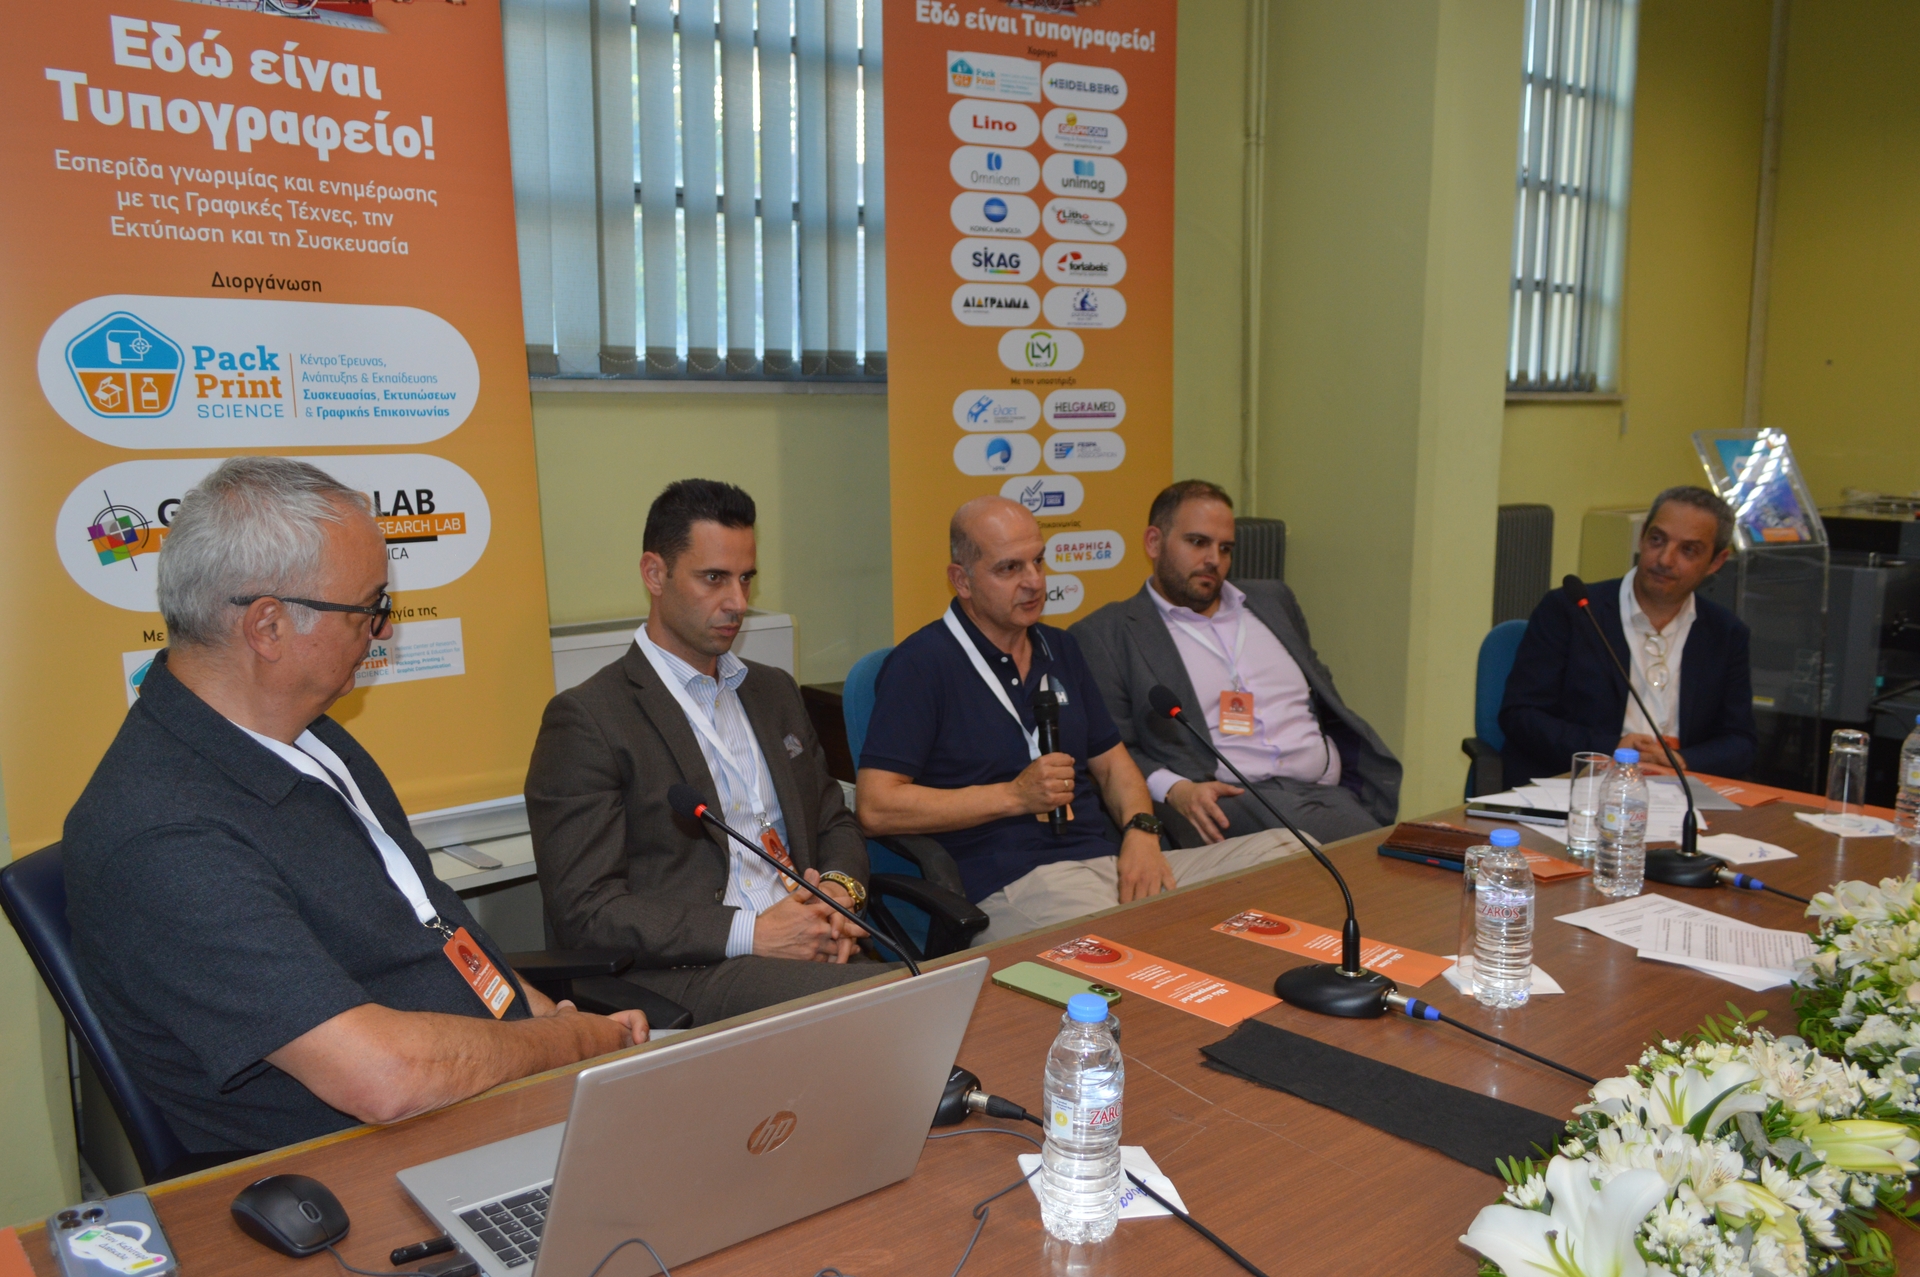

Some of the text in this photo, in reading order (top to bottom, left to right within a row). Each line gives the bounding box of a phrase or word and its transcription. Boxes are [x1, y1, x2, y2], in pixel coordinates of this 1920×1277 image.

[916, 0, 1156, 53] Εδώ είναι Τυπογραφείο!
[110, 15, 382, 100] Εδώ είναι
[975, 67, 996, 78] Pack
[976, 76, 996, 86] Print
[1051, 78, 1119, 95] HEIDELBERG
[45, 67, 436, 162] Τυπογραφείο!
[972, 114, 1017, 132] Lino
[54, 149, 438, 207] Εσπερίδα γνωριμίας και ενημέρωσης
[970, 170, 1020, 187] Omnicom
[1061, 175, 1105, 193] unimag
[117, 190, 394, 228] με τις Γραφικές Τέχνες, την
[110, 215, 409, 256] Εκτύπωση και τη Συσκευασία
[211, 271, 322, 293] Διοργάνωση
[191, 345, 281, 371] Pack
[299, 352, 387, 369] Κέντρο Έρευνας,
[195, 373, 283, 399] Print
[301, 370, 438, 387] Ανάπτυξης & Εκπαίδευσης
[1011, 377, 1021, 385] Με
[1023, 378, 1034, 386] την
[303, 387, 457, 403] Συσκευασίας, Εκτυπώσεων
[197, 403, 285, 419] SCIENCE
[305, 404, 450, 421] & Γραφικής Επικοινωνίας
[1055, 401, 1116, 414] HELGRAMED
[378, 518, 461, 535] SEARCH LAB
[388, 547, 409, 560] ICA
[1055, 541, 1112, 552] GRAPHICA
[1055, 551, 1112, 563] NEWS.GR
[143, 606, 437, 643] Με ηγία της
[356, 668, 389, 679] SCIENCE
[1481, 904, 1520, 920] ZAROS
[748, 1111, 796, 1155] hp
